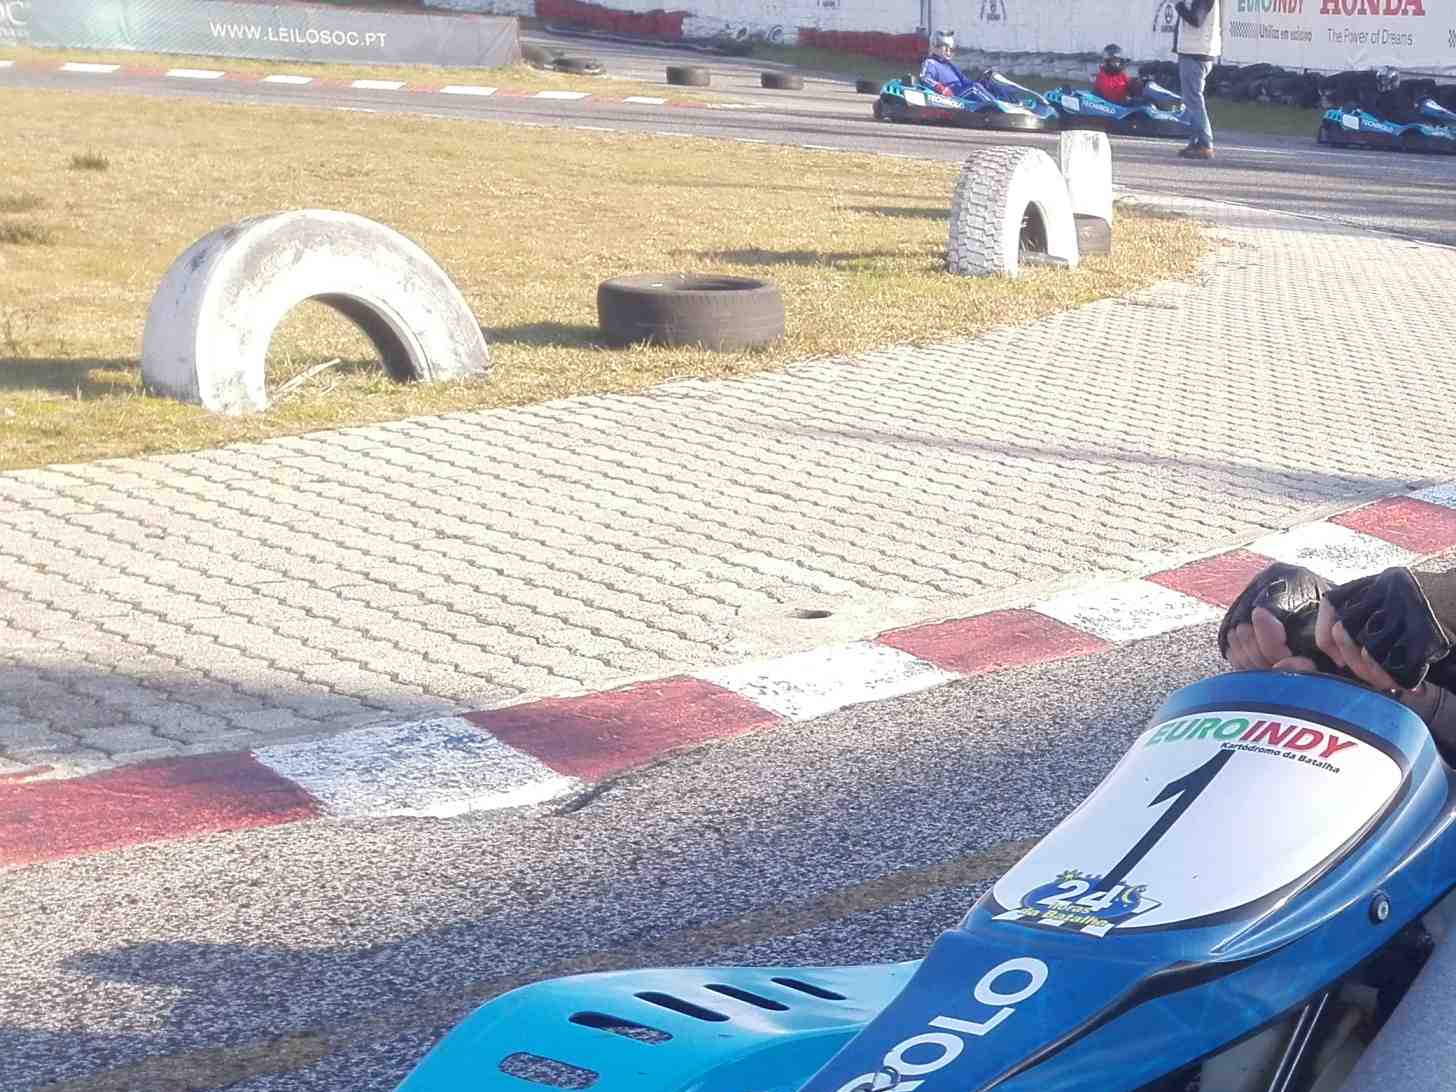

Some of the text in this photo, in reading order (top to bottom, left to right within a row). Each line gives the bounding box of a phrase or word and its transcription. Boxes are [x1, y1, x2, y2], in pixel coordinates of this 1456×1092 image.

[209, 22, 387, 48] WWW.LEILOSOC.PT
[1146, 718, 1358, 760] EUROINDY
[1282, 750, 1297, 761] da
[1298, 755, 1340, 774] Batalha
[1100, 749, 1237, 894] 1
[1036, 880, 1125, 912] 24
